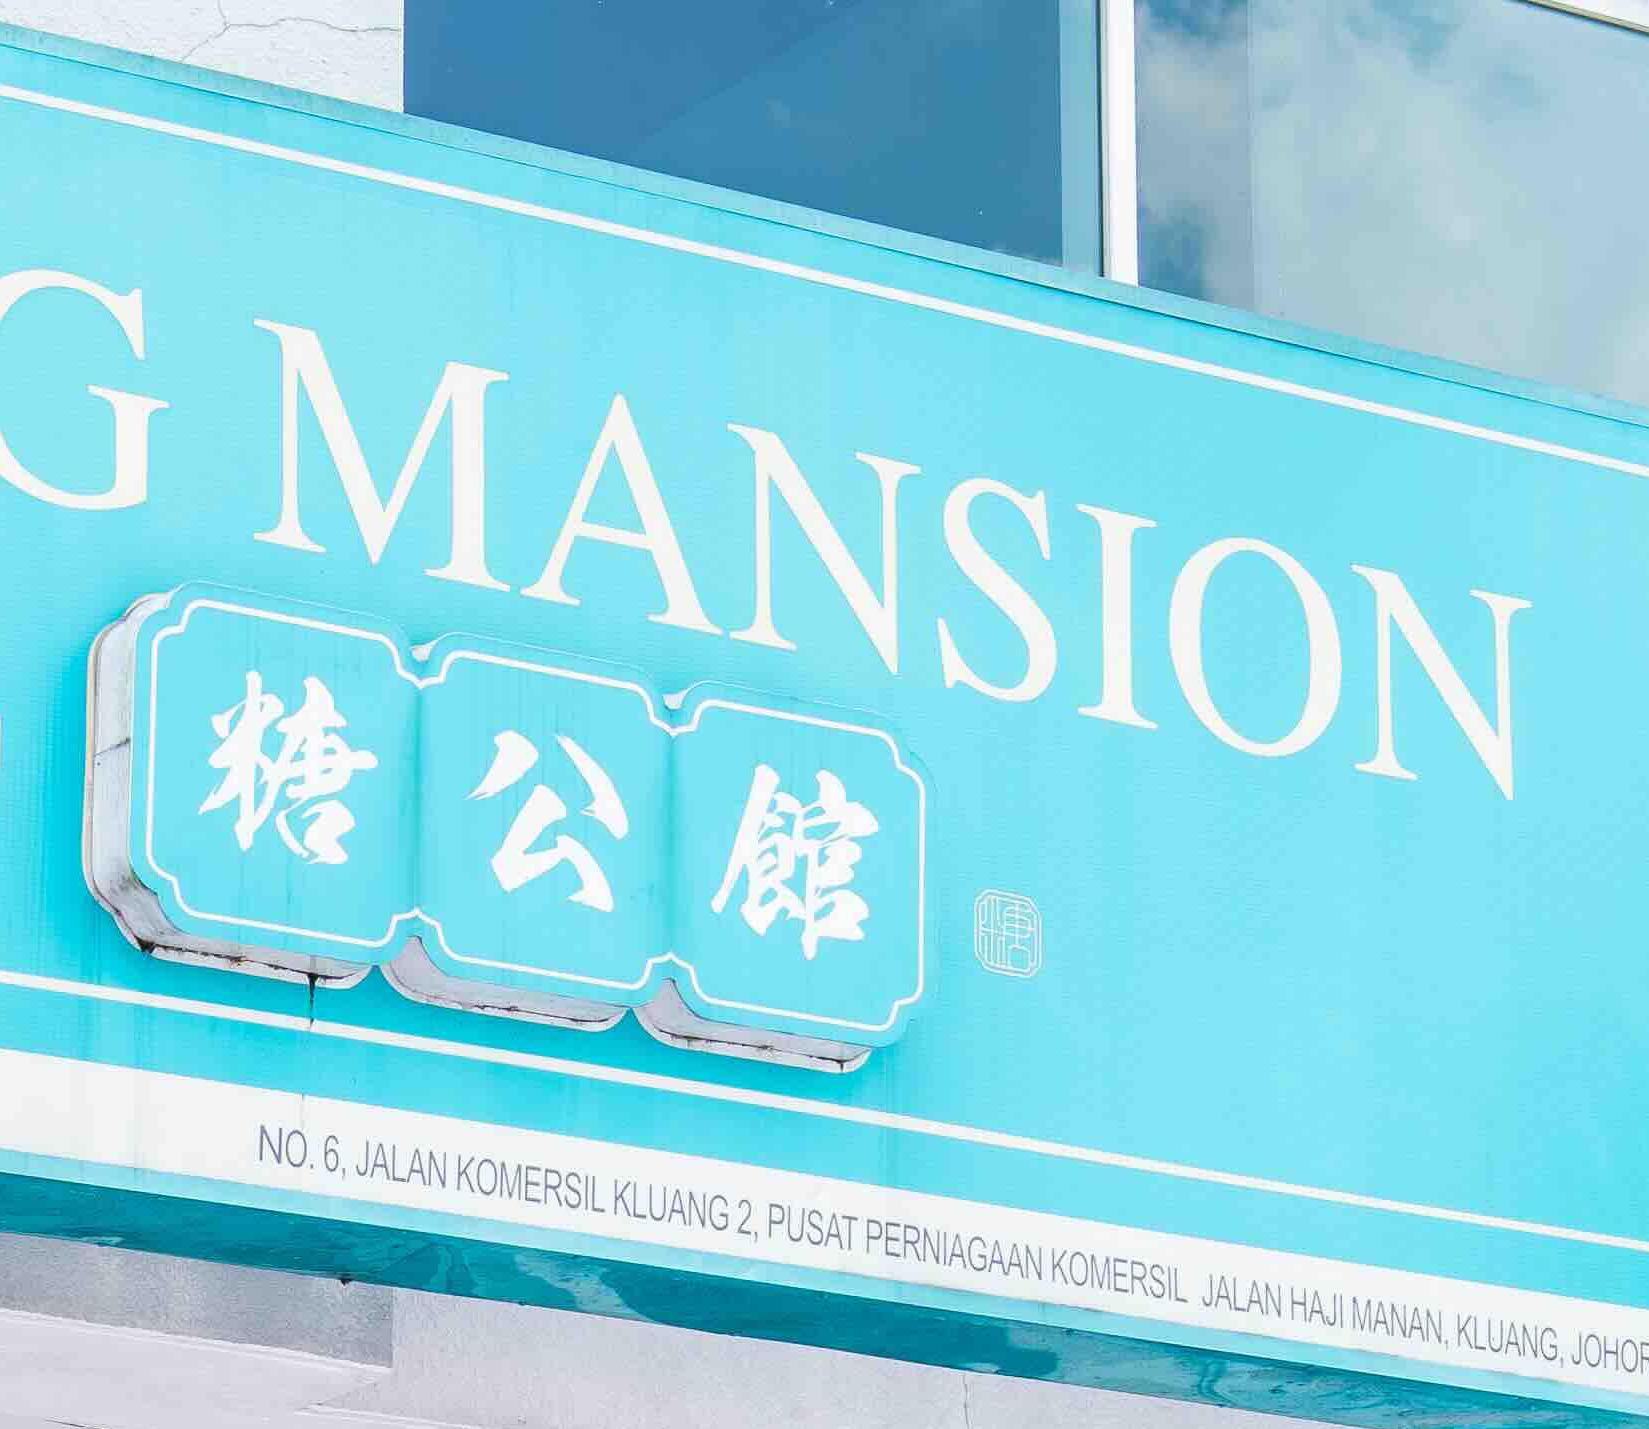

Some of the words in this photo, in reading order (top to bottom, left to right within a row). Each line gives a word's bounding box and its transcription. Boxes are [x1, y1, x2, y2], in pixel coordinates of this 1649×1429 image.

[253, 318, 1533, 801] MANSION
[199, 669, 882, 961] 糖公館
[258, 1124, 315, 1169] NO.
[323, 1133, 347, 1179] 6,
[355, 1140, 448, 1188] JALAN
[455, 1157, 606, 1213] KOMERSIL
[613, 1180, 730, 1232] KLUANG
[736, 1200, 760, 1242] 2,
[767, 1203, 858, 1250] PUSAT
[864, 1218, 1043, 1281] PERNIAGAAN
[1050, 1246, 1189, 1303] KOMERSIL
[1201, 1272, 1283, 1318] JALAN
[1290, 1287, 1346, 1326] HAJI
[1351, 1296, 1450, 1350] MANAN,
[1456, 1316, 1564, 1368] KLUANG,
